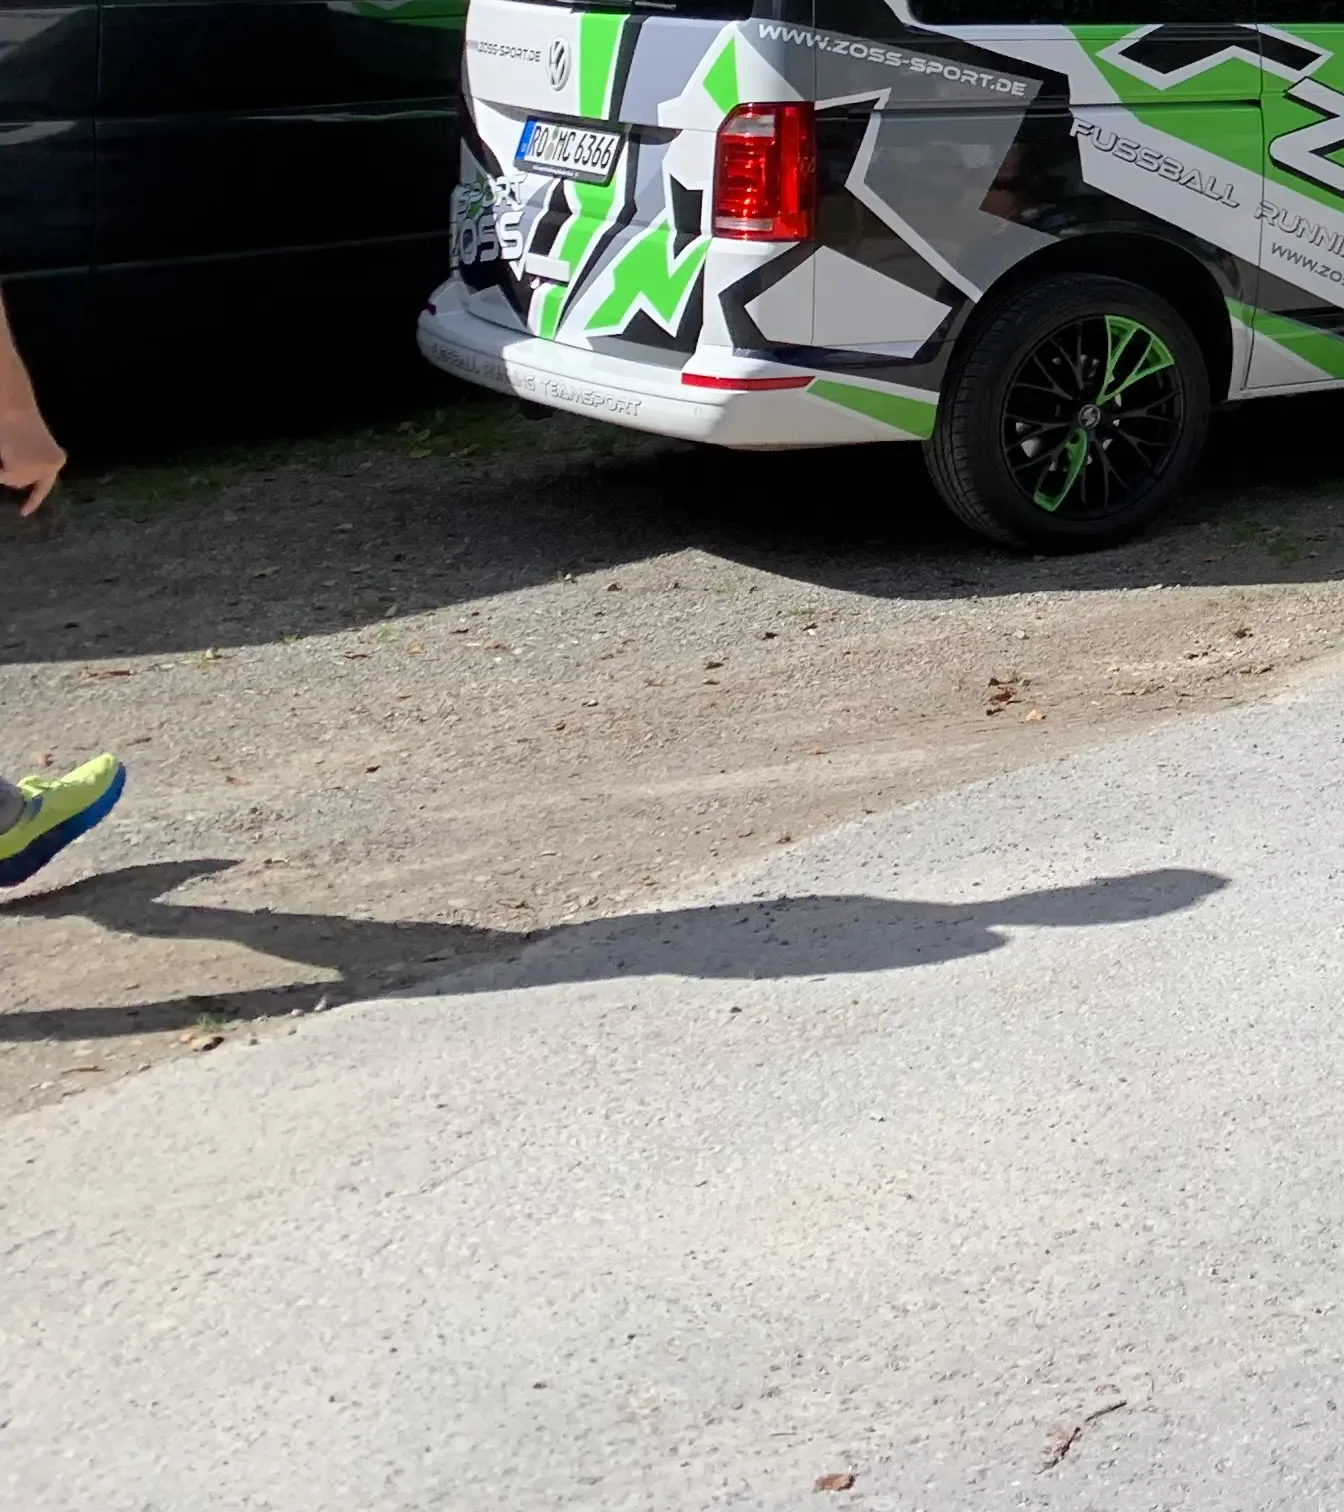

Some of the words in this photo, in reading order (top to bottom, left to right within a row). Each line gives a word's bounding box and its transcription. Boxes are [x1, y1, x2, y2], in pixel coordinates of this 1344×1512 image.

[758, 23, 1027, 97] WWW.ZOSS-SPORT.DE
[574, 133, 615, 169] 6366
[1068, 116, 1240, 209] FUSSBALL
[540, 378, 642, 417] TEAMSPORT
